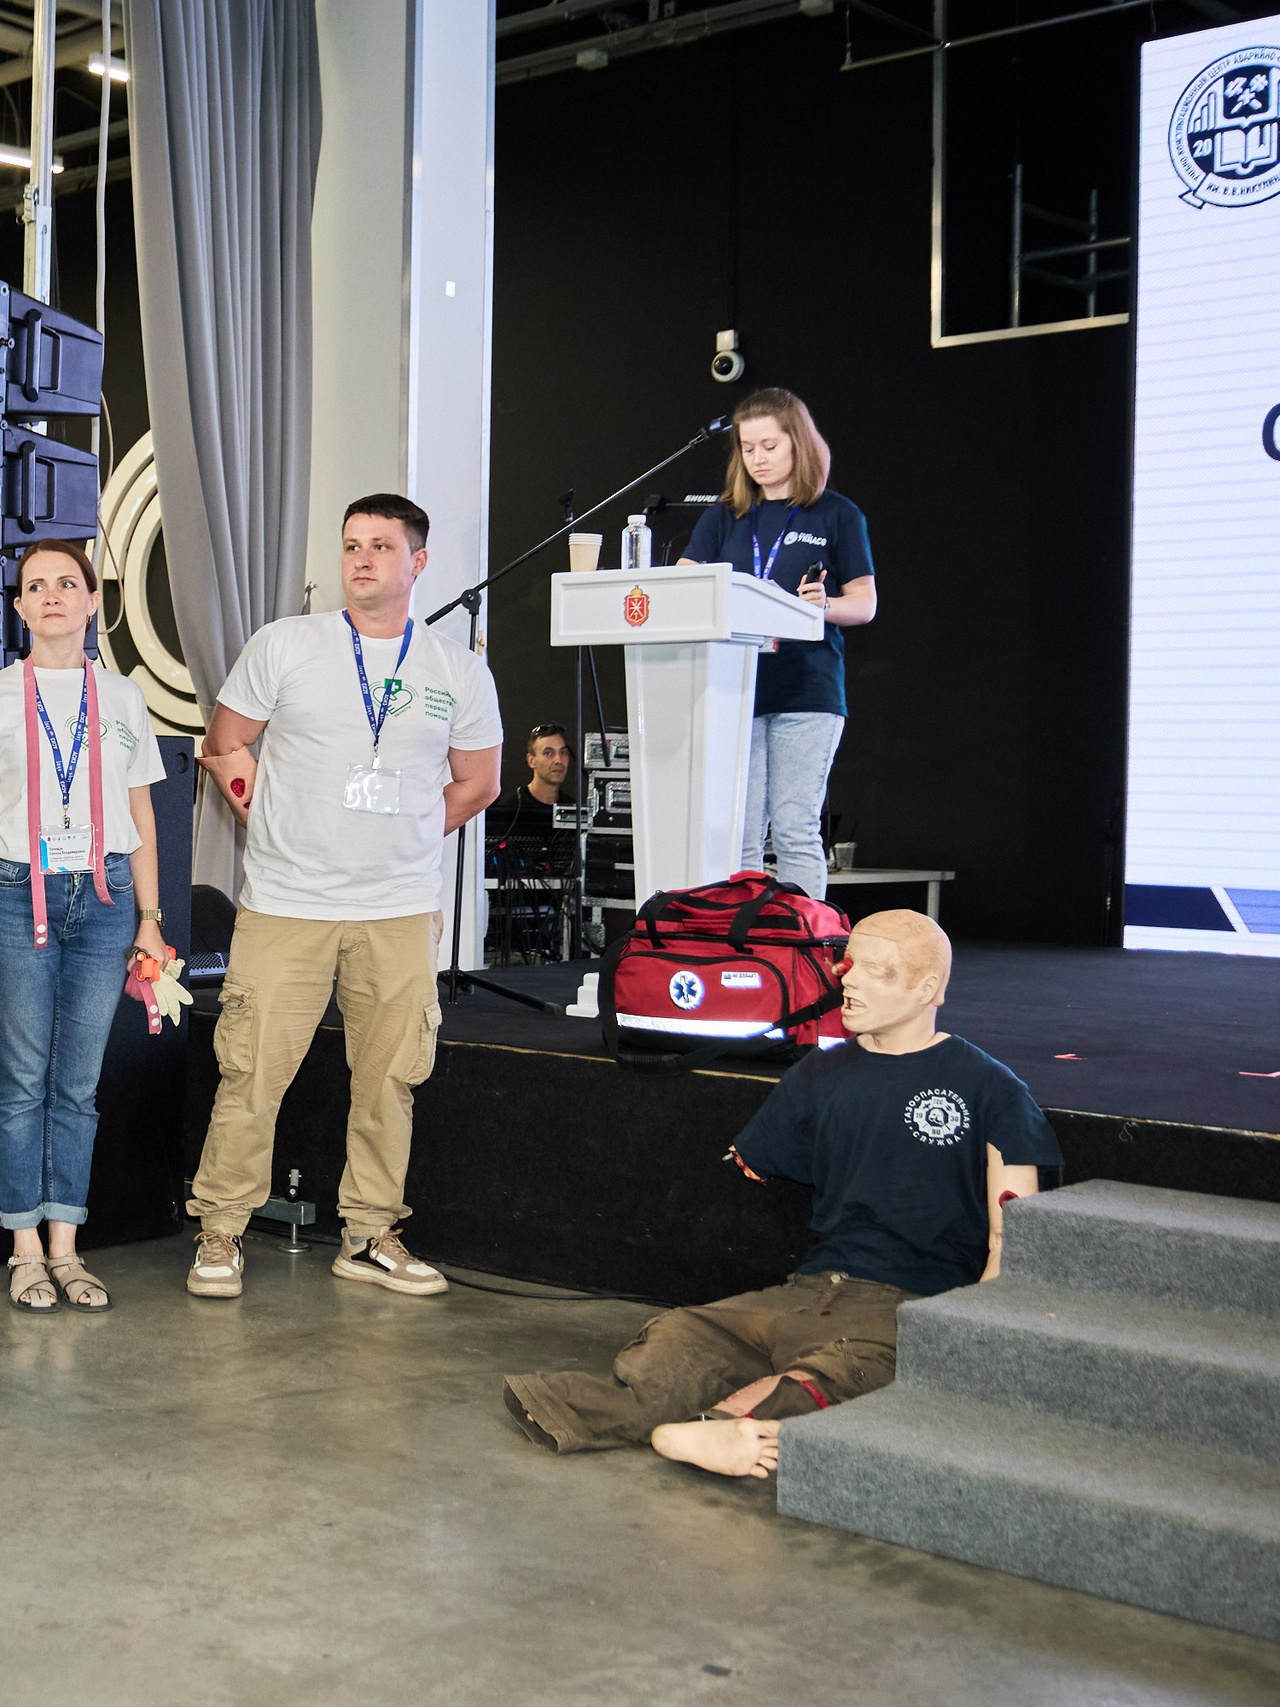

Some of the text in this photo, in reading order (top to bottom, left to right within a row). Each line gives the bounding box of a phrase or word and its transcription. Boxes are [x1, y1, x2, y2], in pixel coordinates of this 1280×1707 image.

[1192, 138, 1213, 158] 20
[904, 1088, 971, 1129] ГАЗОСПАСАТЕЛЬНАЯ
[912, 1131, 961, 1146] СЛУЖБА
